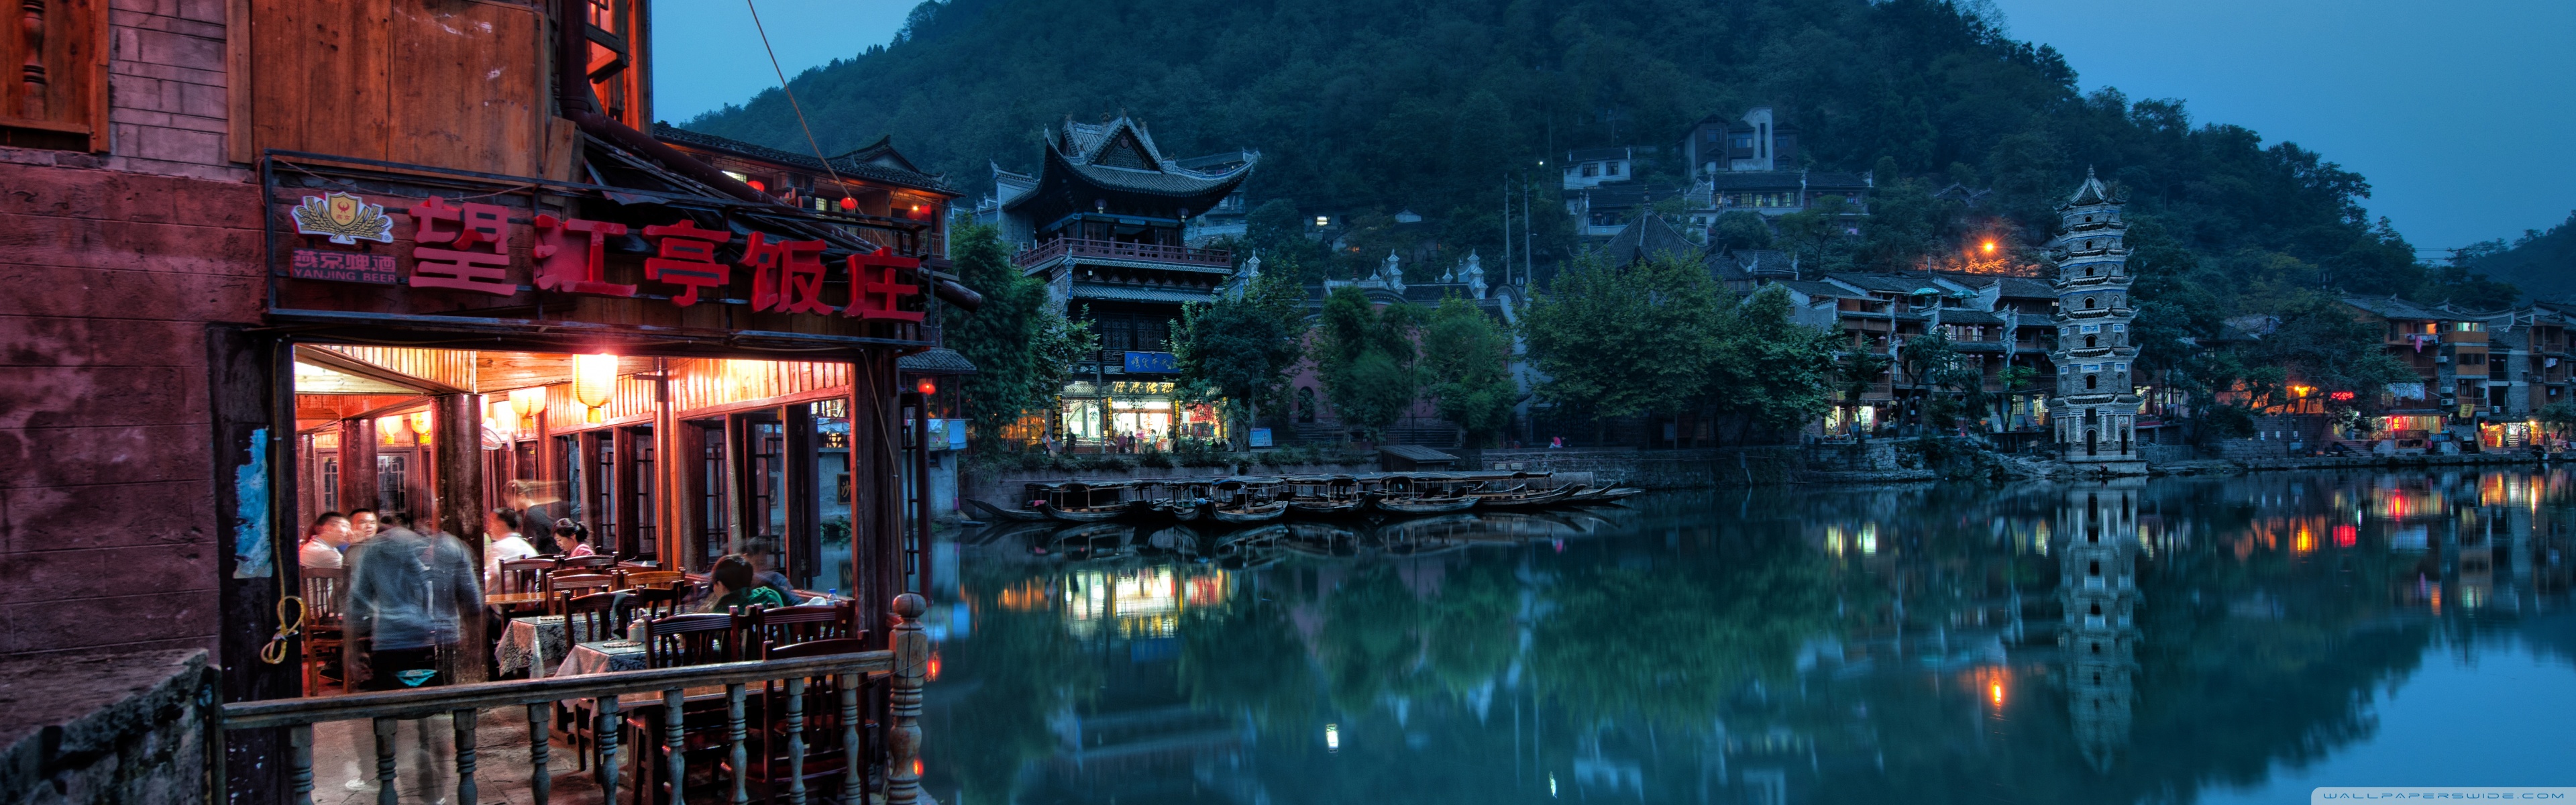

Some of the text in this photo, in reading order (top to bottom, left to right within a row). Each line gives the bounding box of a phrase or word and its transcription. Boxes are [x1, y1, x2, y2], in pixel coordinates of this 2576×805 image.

[294, 250, 396, 272] 燕京啤酒
[409, 196, 925, 322] 望江亭饭庄
[294, 269, 396, 282] YANJING BEER
